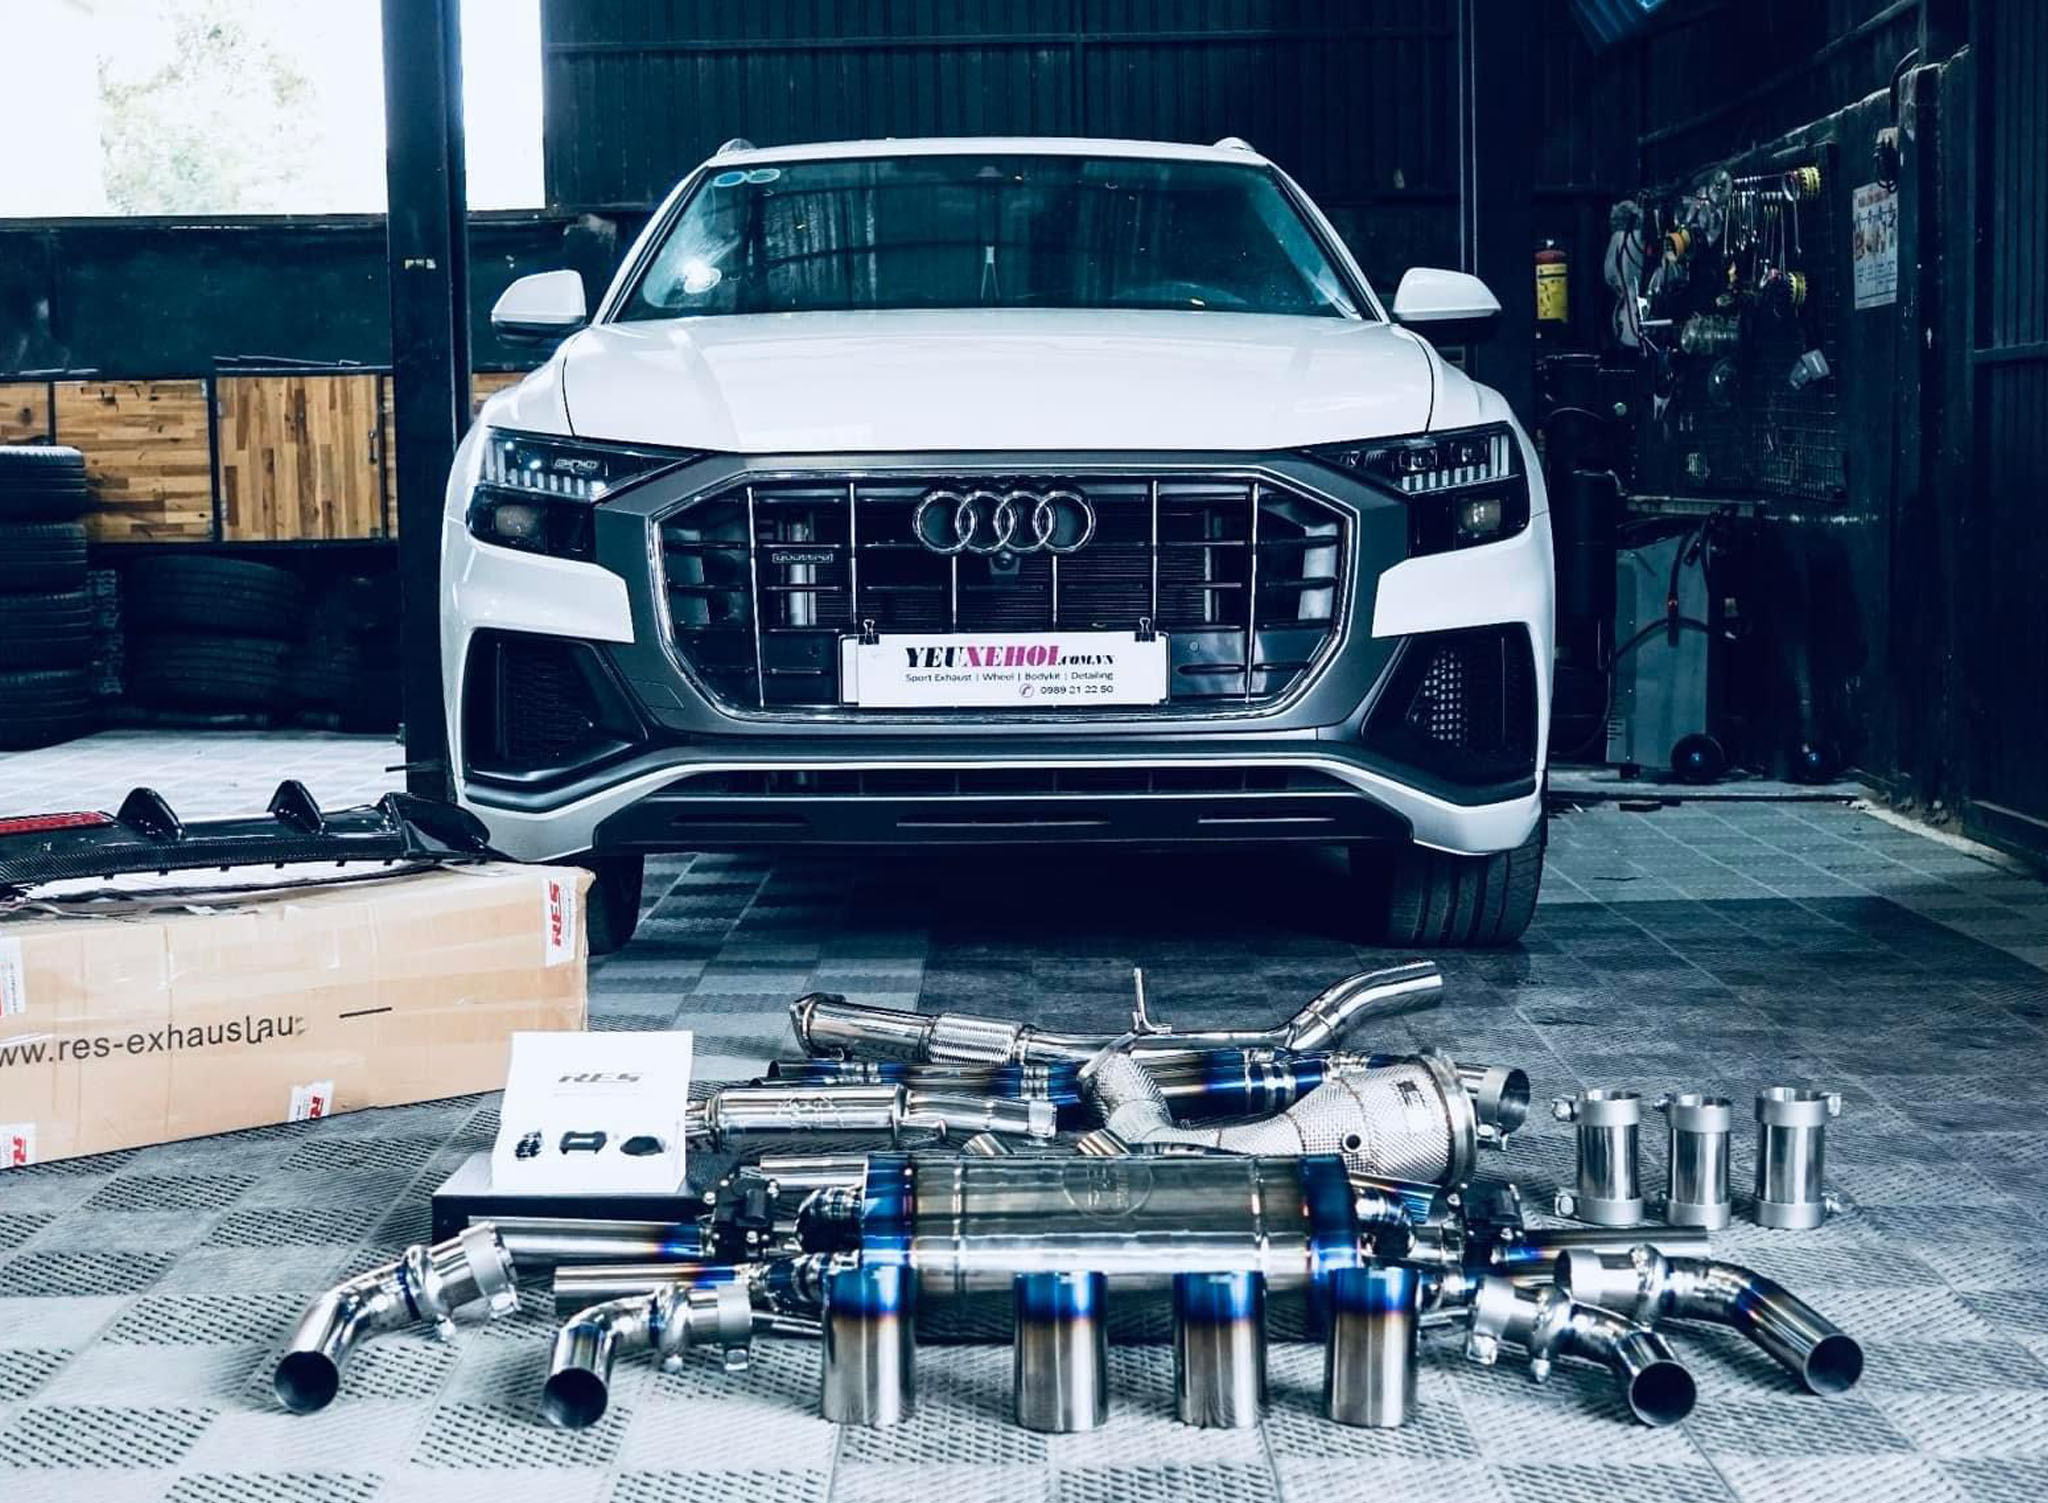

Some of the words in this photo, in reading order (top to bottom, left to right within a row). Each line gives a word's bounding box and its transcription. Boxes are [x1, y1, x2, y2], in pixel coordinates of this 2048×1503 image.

[905, 673, 932, 683] Sport
[934, 673, 972, 682] Exhaust
[982, 672, 1014, 681] Wheel
[1025, 672, 1060, 682] Bodykit
[1071, 671, 1114, 681] Detailing
[1040, 685, 1067, 695] 0989
[1069, 685, 1081, 694] 21
[1084, 685, 1098, 694] 22
[1100, 684, 1114, 693] 50
